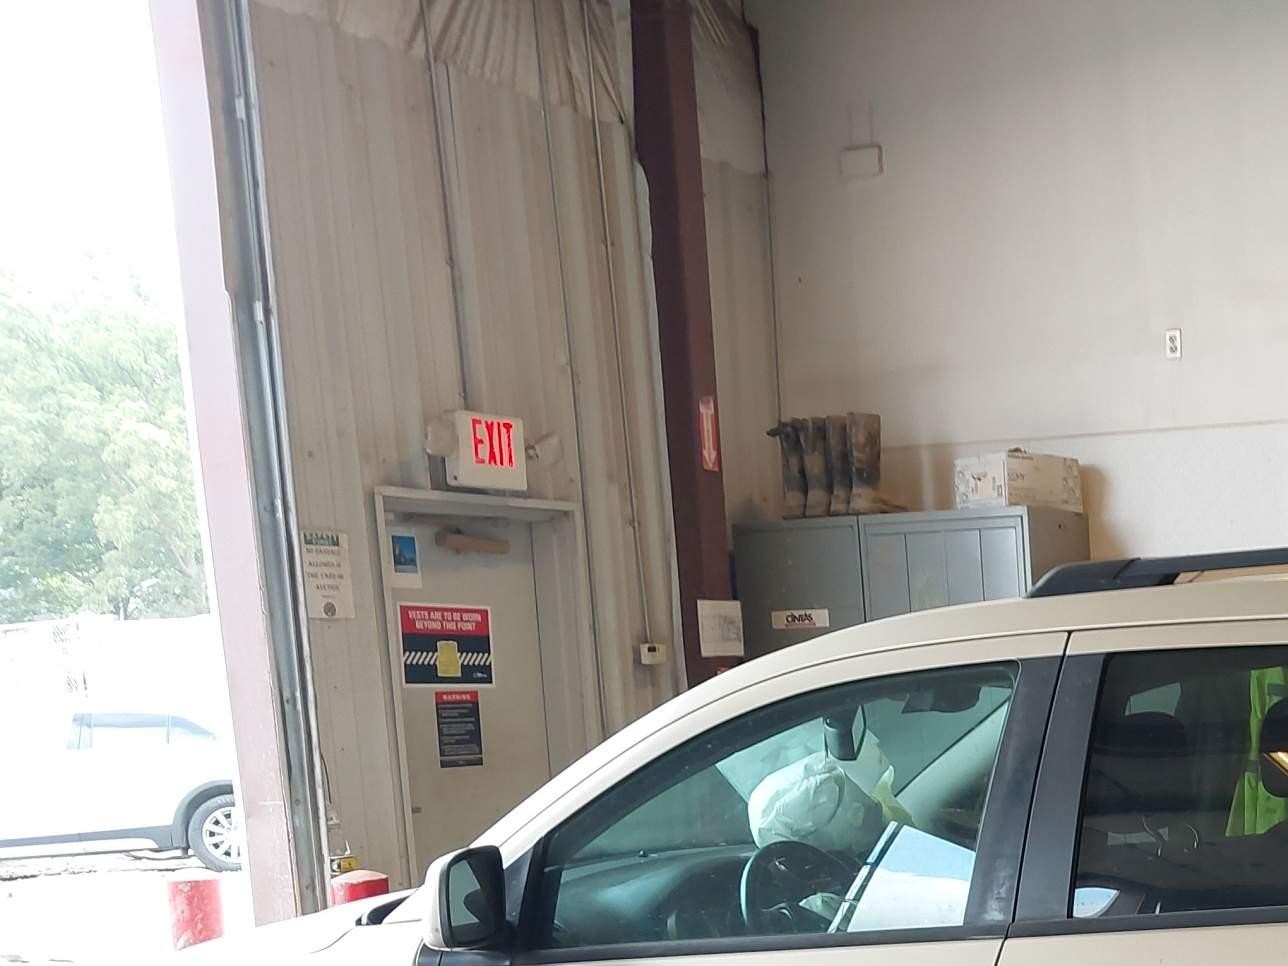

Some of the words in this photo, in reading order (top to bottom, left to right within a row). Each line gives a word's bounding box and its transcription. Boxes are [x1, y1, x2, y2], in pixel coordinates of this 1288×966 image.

[471, 418, 515, 468] EXIT
[408, 610, 428, 620] VESTS
[430, 611, 442, 621] ARE
[443, 612, 452, 621] TO
[452, 612, 461, 622] BE
[415, 620, 441, 630] BEYOND
[441, 621, 457, 630] THIS
[457, 621, 476, 632] POINT
